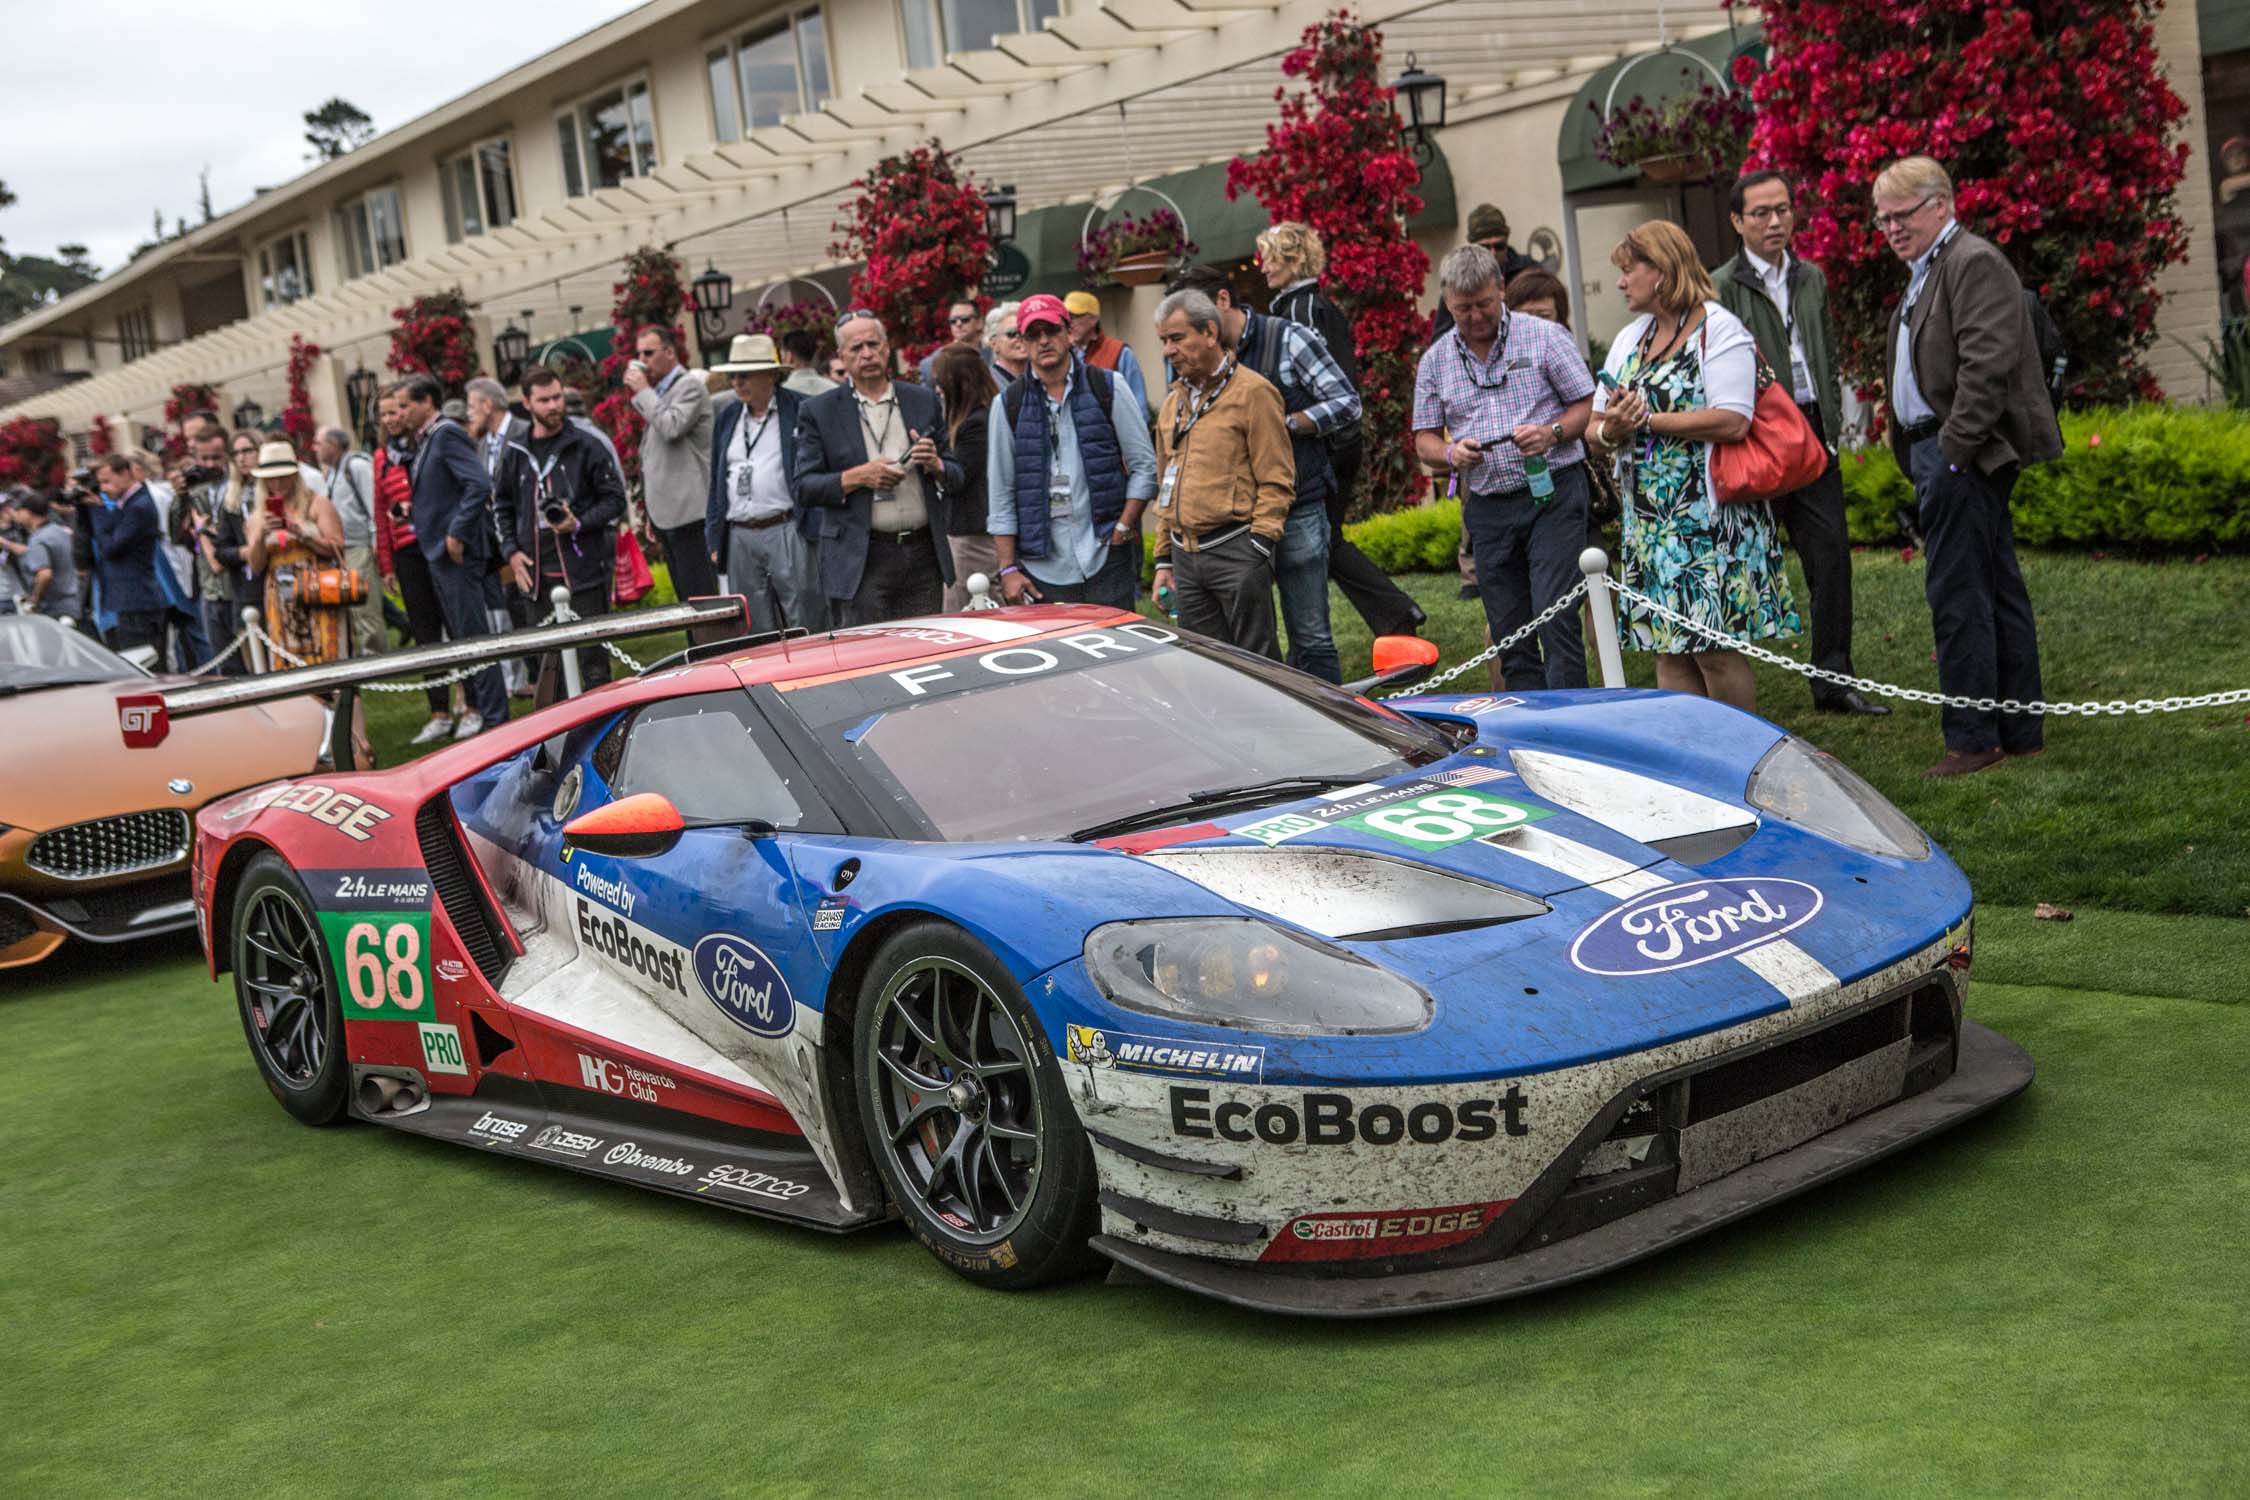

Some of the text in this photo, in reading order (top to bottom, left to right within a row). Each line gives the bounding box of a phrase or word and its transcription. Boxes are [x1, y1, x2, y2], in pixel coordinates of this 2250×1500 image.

[889, 624, 1179, 696] FORD
[121, 705, 163, 734] GT
[1355, 796, 1382, 806] LE
[1381, 783, 1435, 800] MANS
[269, 784, 395, 842] EDGE
[1241, 817, 1316, 840] PRO
[1364, 794, 1528, 843] 68
[367, 884, 387, 897] LE
[387, 883, 428, 897] MANS
[576, 862, 636, 918] Powered by
[814, 922, 841, 930] RACING
[1621, 889, 1787, 961] Ford
[576, 896, 688, 998] EcoBoost
[345, 922, 425, 1011] 68
[712, 944, 774, 1024] Ford
[422, 1031, 462, 1066] PRO
[1118, 1042, 1258, 1073] MICHELIN
[577, 1053, 677, 1095] IHG Rewards
[629, 1081, 658, 1103] Club
[472, 1111, 529, 1139] brose
[1169, 1085, 1530, 1145] EcoBoost
[625, 1147, 695, 1176] brembo
[707, 1164, 810, 1197] sparco
[1313, 1208, 1485, 1238] Castrol EDGE
